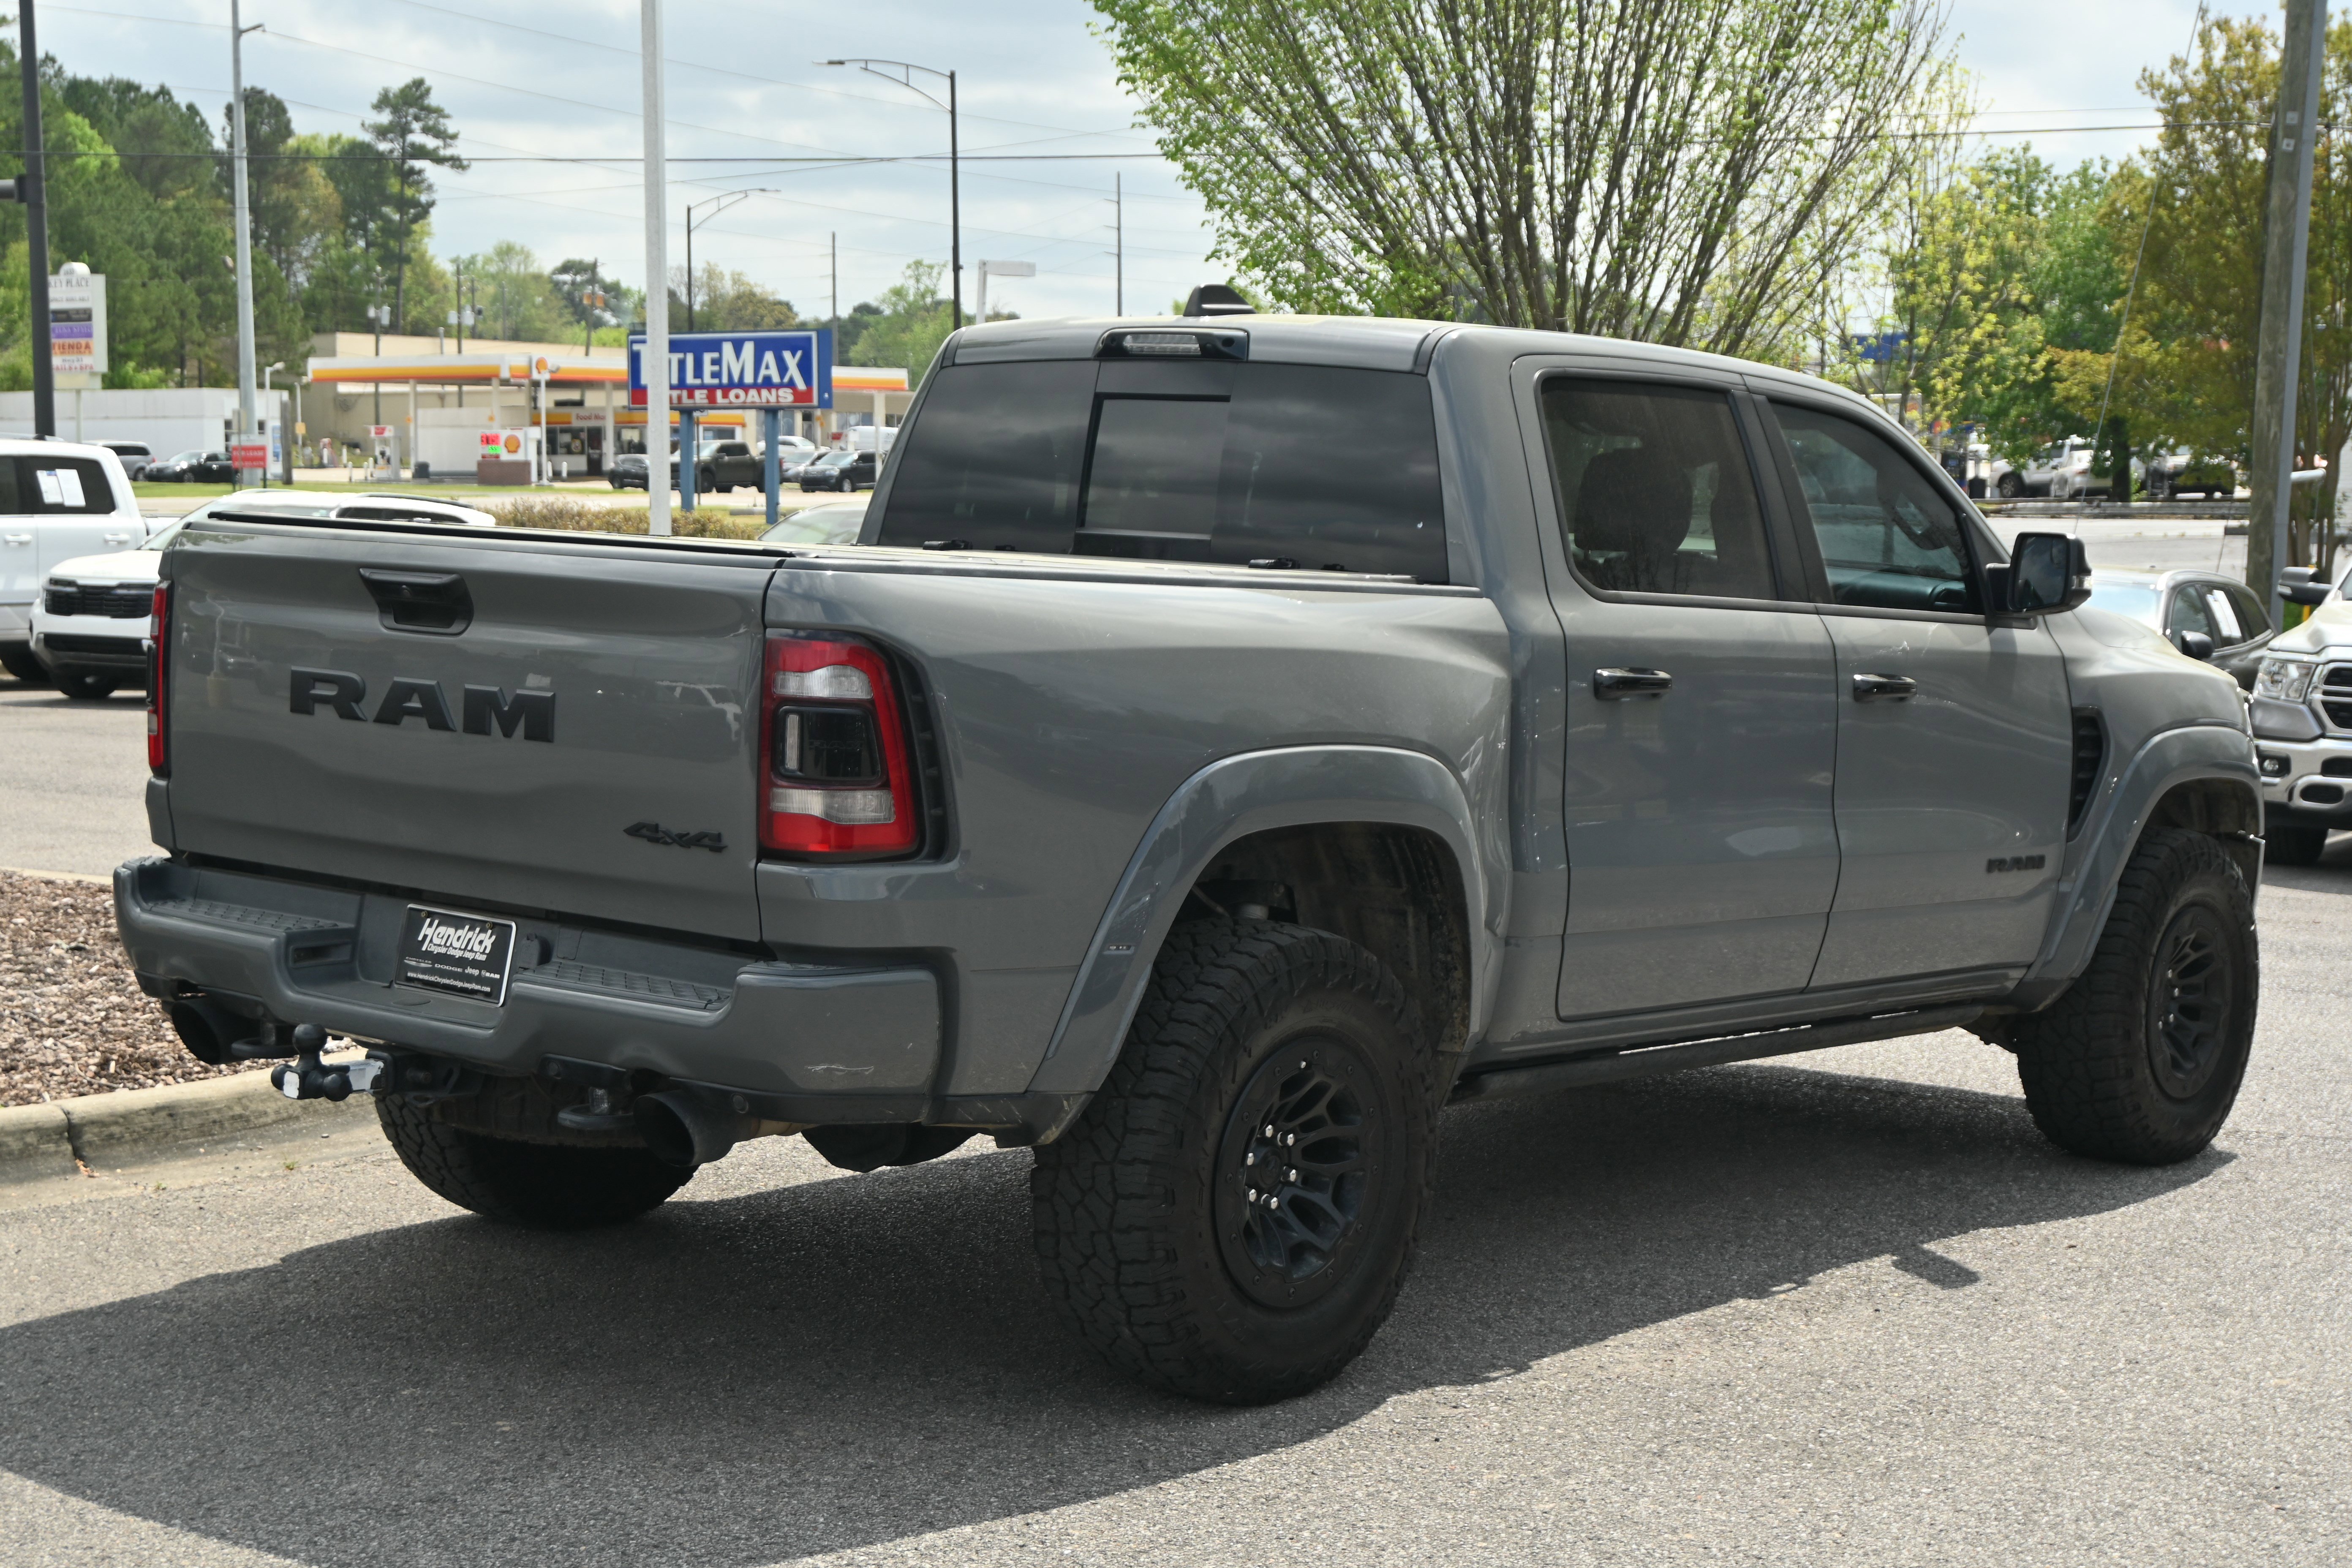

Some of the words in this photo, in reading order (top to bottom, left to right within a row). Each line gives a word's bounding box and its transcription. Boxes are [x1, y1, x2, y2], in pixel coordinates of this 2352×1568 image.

[66, 278, 90, 287] PLACE
[669, 389, 709, 404] TLE
[716, 388, 794, 403] LOANS
[290, 665, 555, 743] RAM
[1986, 854, 2046, 873] RAM
[418, 918, 496, 954] Hendrick
[427, 943, 448, 954] Chrysler
[447, 947, 463, 958] Dodge
[464, 950, 475, 960] Jeep
[474, 953, 487, 961] Ram
[435, 964, 463, 972] DODGE
[465, 966, 479, 976] Jeep
[407, 972, 490, 992] www.HendrickChryslerDodgeJeepRam.com
